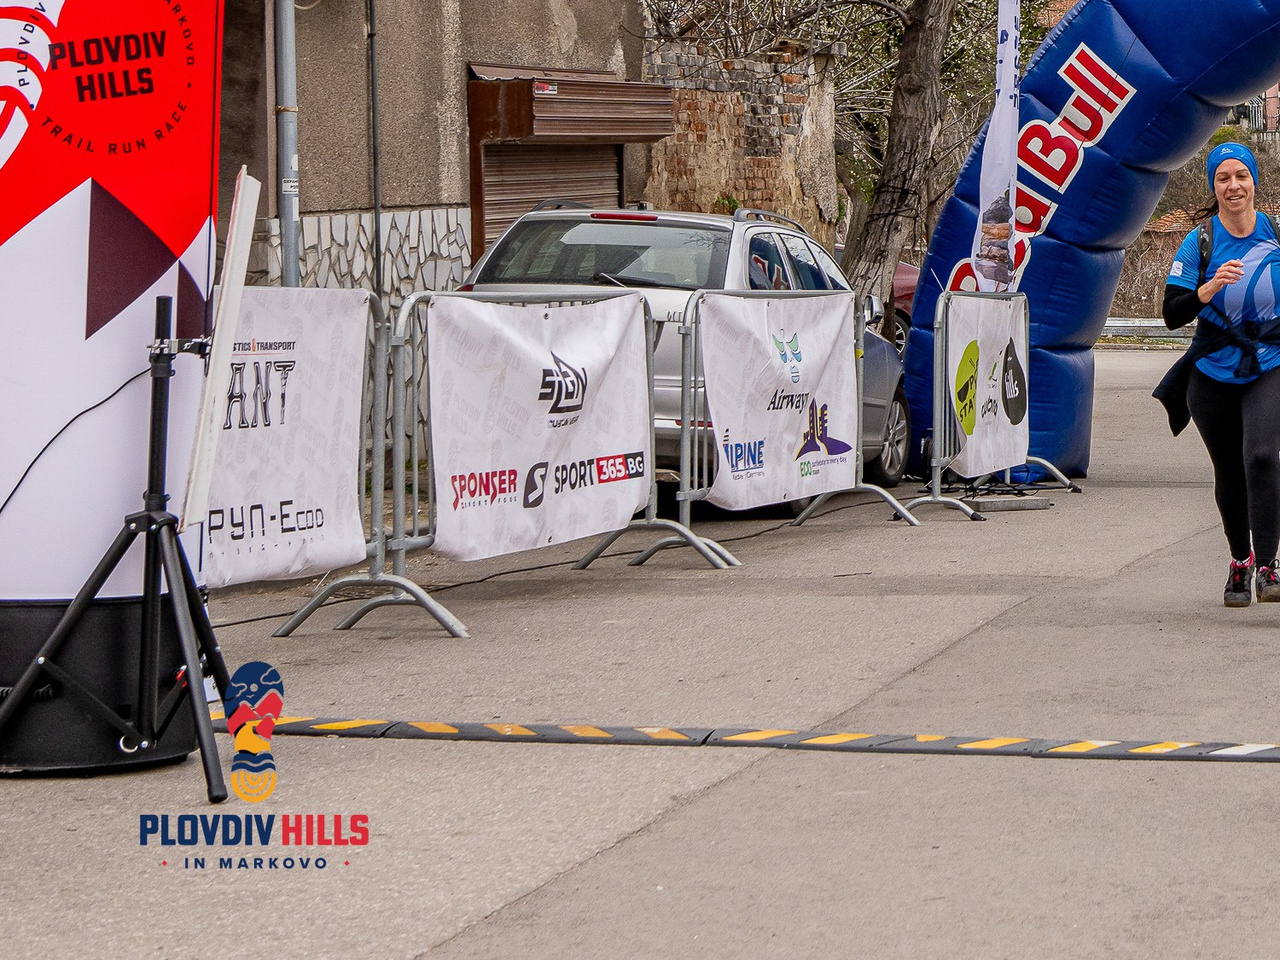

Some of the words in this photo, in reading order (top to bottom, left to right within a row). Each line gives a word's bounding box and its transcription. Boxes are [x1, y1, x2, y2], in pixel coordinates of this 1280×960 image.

[16, 1, 47, 88] PLOVDIV
[48, 30, 167, 71] PLOVDIV
[75, 67, 155, 102] HILLS
[41, 116, 95, 153] TRAIL
[108, 138, 147, 155] RUN
[154, 100, 187, 141] RACE
[1016, 46, 1132, 189] Bull
[451, 469, 517, 511] SPONSER
